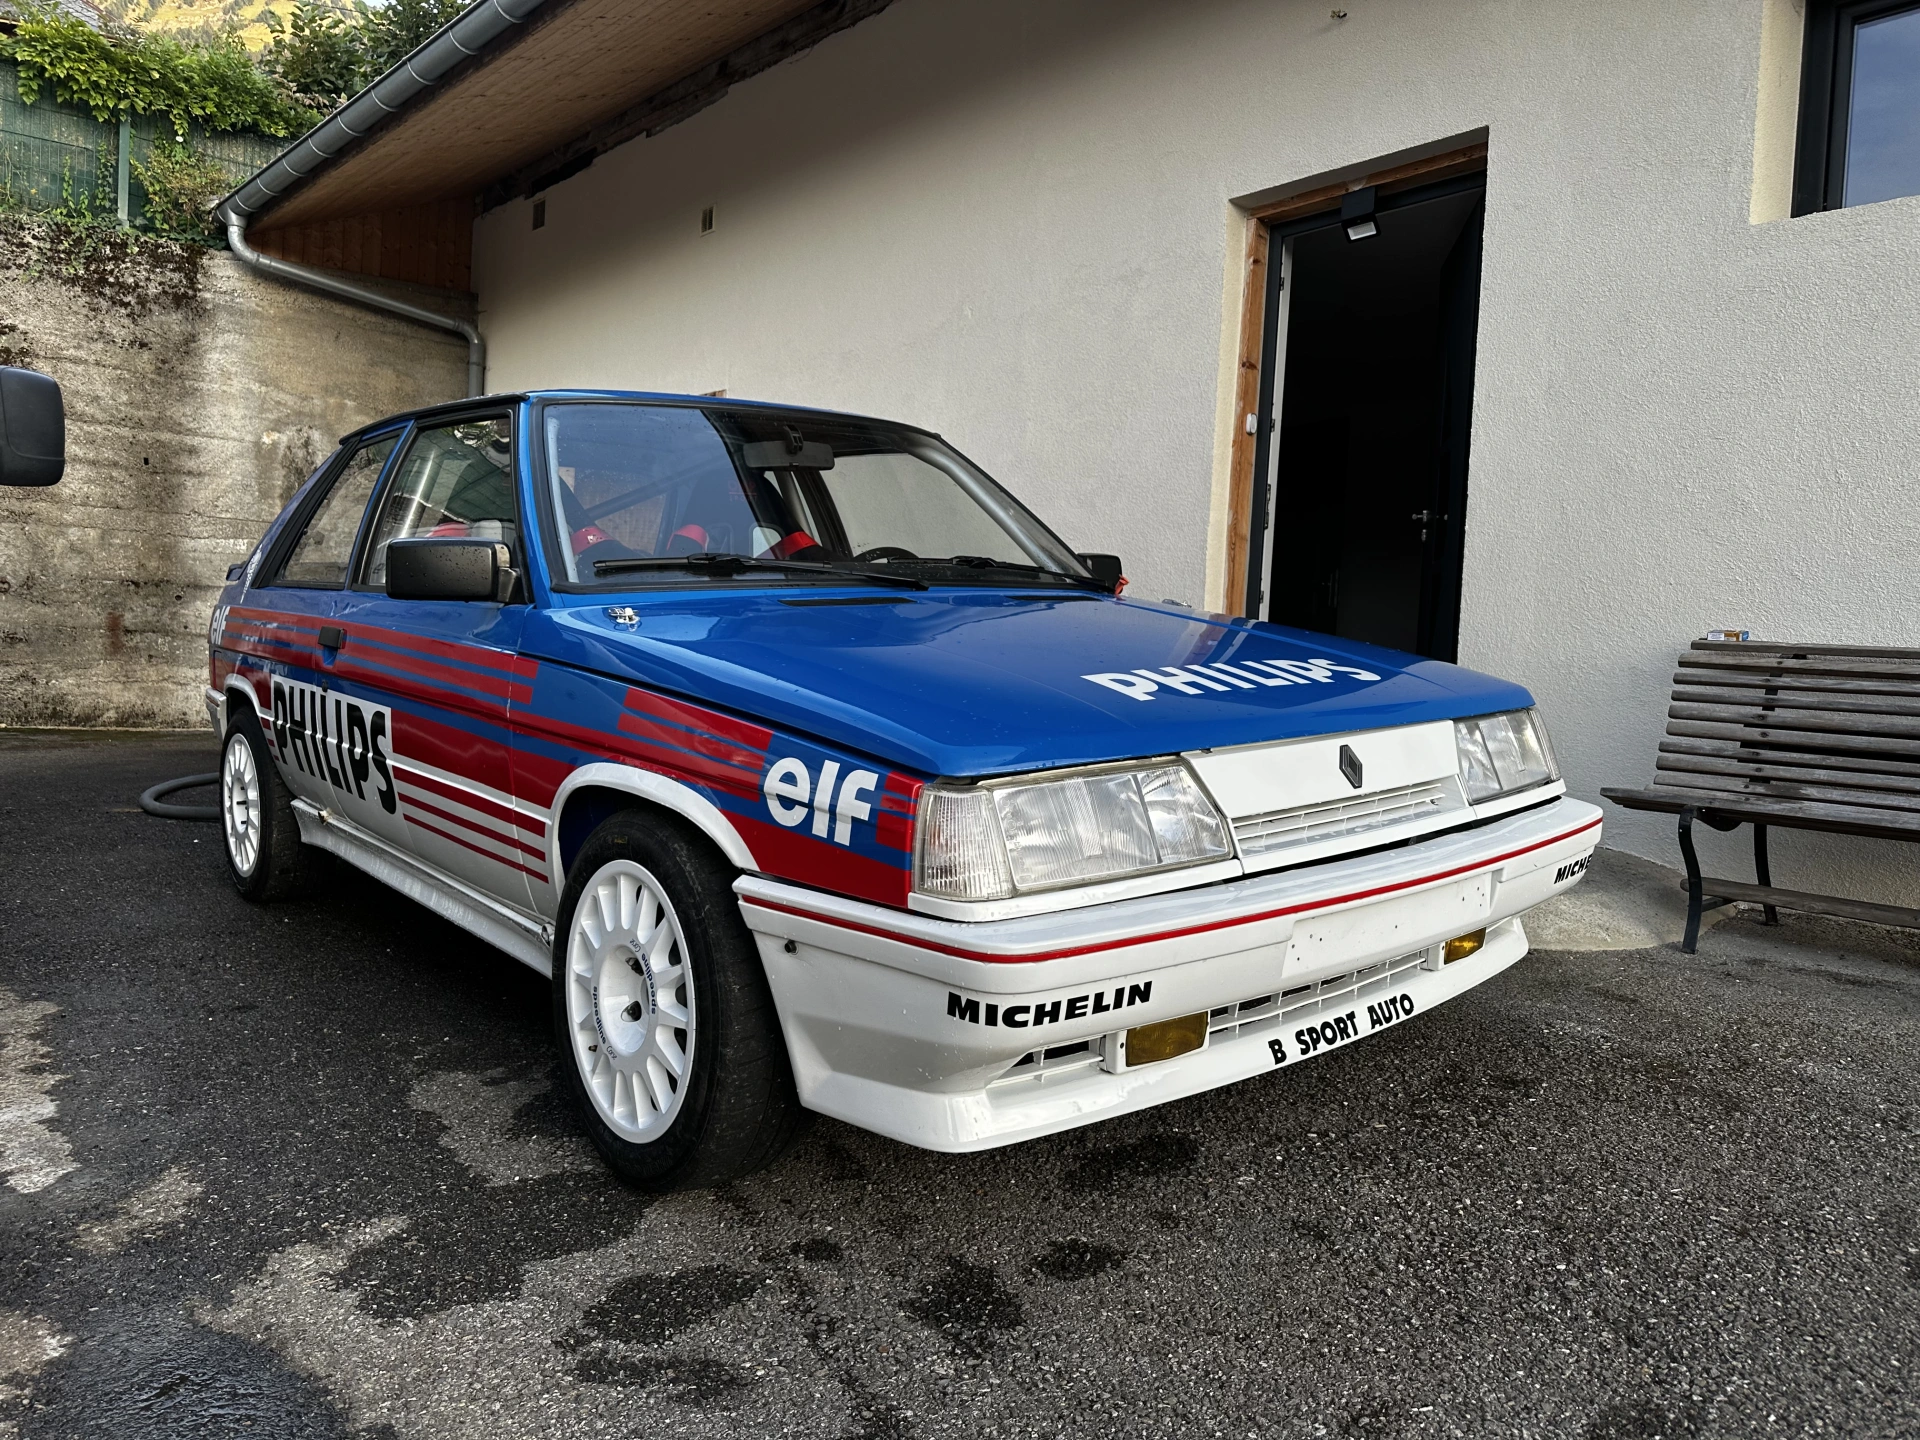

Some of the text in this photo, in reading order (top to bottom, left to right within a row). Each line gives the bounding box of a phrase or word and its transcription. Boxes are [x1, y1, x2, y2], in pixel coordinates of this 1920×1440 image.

[210, 605, 230, 646] elf
[1080, 658, 1382, 702] PHILIPS
[273, 680, 397, 815] PHILIPS
[764, 757, 879, 847] elf
[641, 953, 656, 1014] speedline
[947, 980, 1153, 1029] MICHELIN
[592, 986, 607, 1044] speedline
[1267, 993, 1415, 1065] B SPORT AUTO
